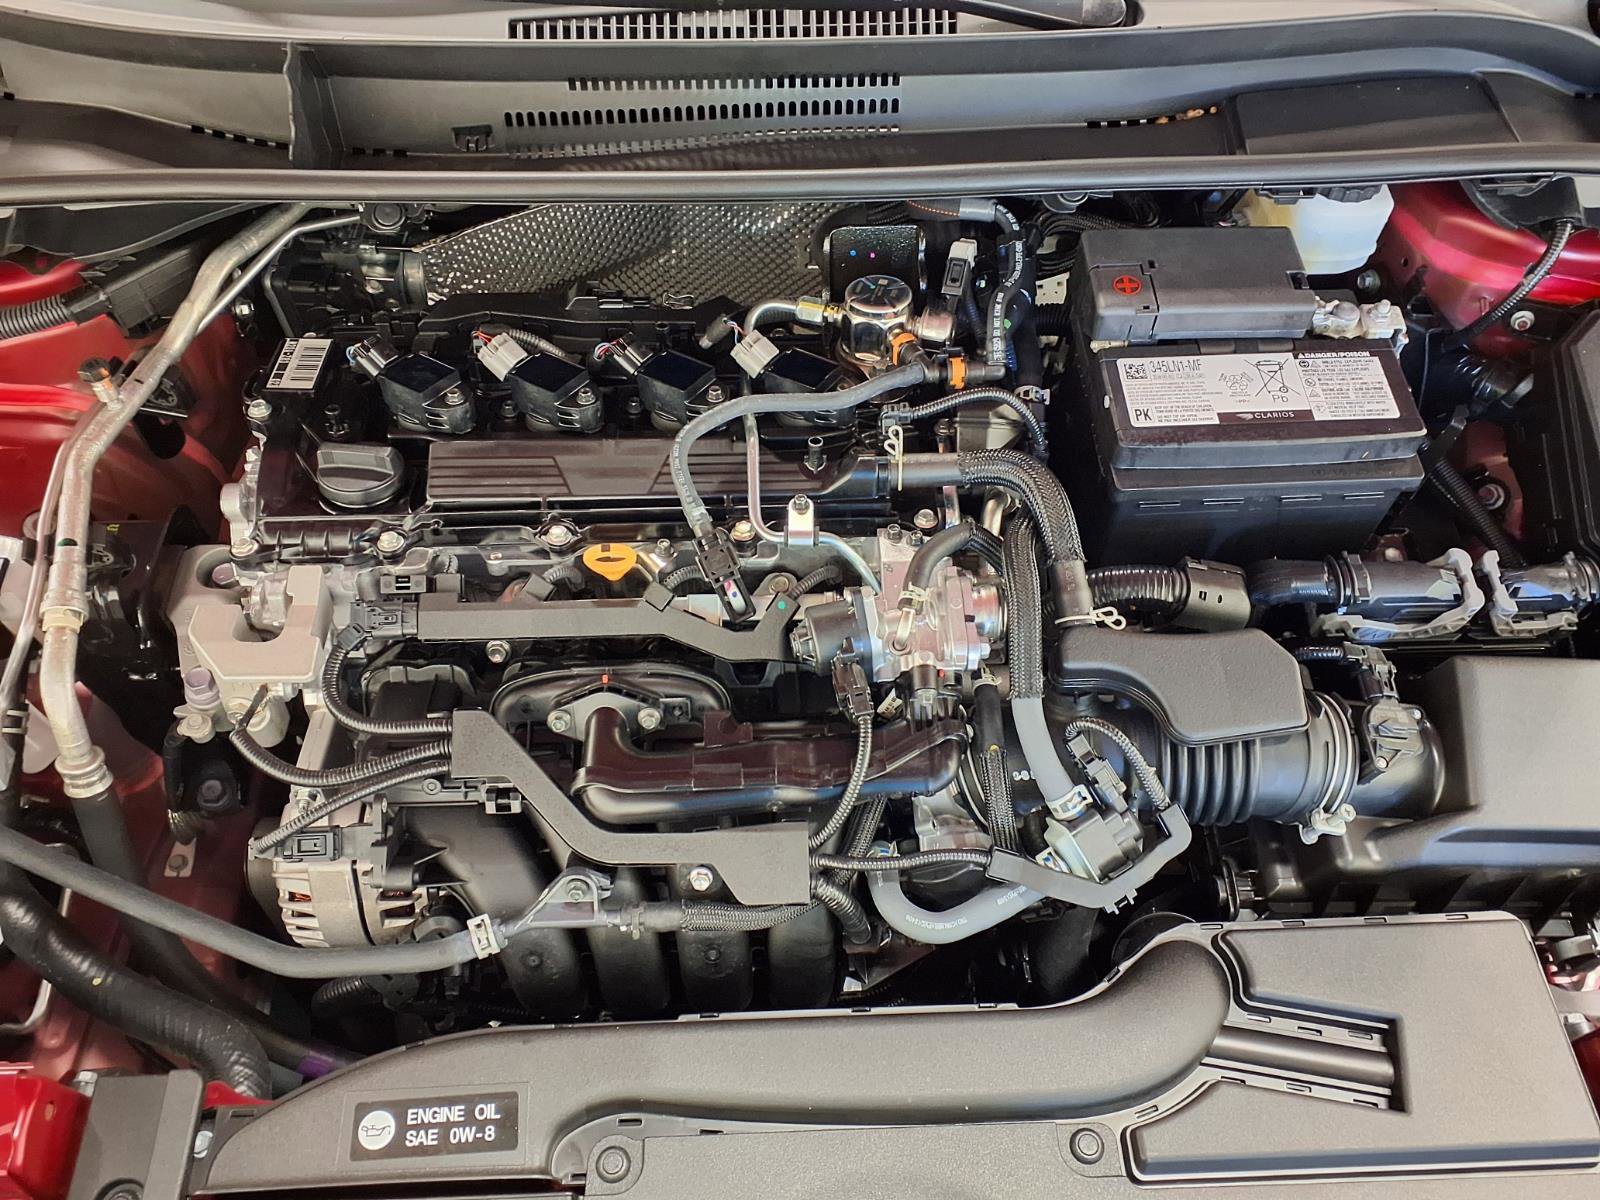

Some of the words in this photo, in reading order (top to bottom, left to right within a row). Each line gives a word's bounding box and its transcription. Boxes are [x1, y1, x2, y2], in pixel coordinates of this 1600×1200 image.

[1149, 359, 1202, 372] 345LN1-MF
[1271, 394, 1289, 403] Pb
[1134, 408, 1152, 422] PK
[1254, 411, 1295, 419] CLARIOS
[406, 1105, 465, 1125] ENGINE
[474, 1103, 501, 1120] OIL
[405, 1129, 439, 1147] SAE
[449, 1125, 496, 1144] 0W-8
